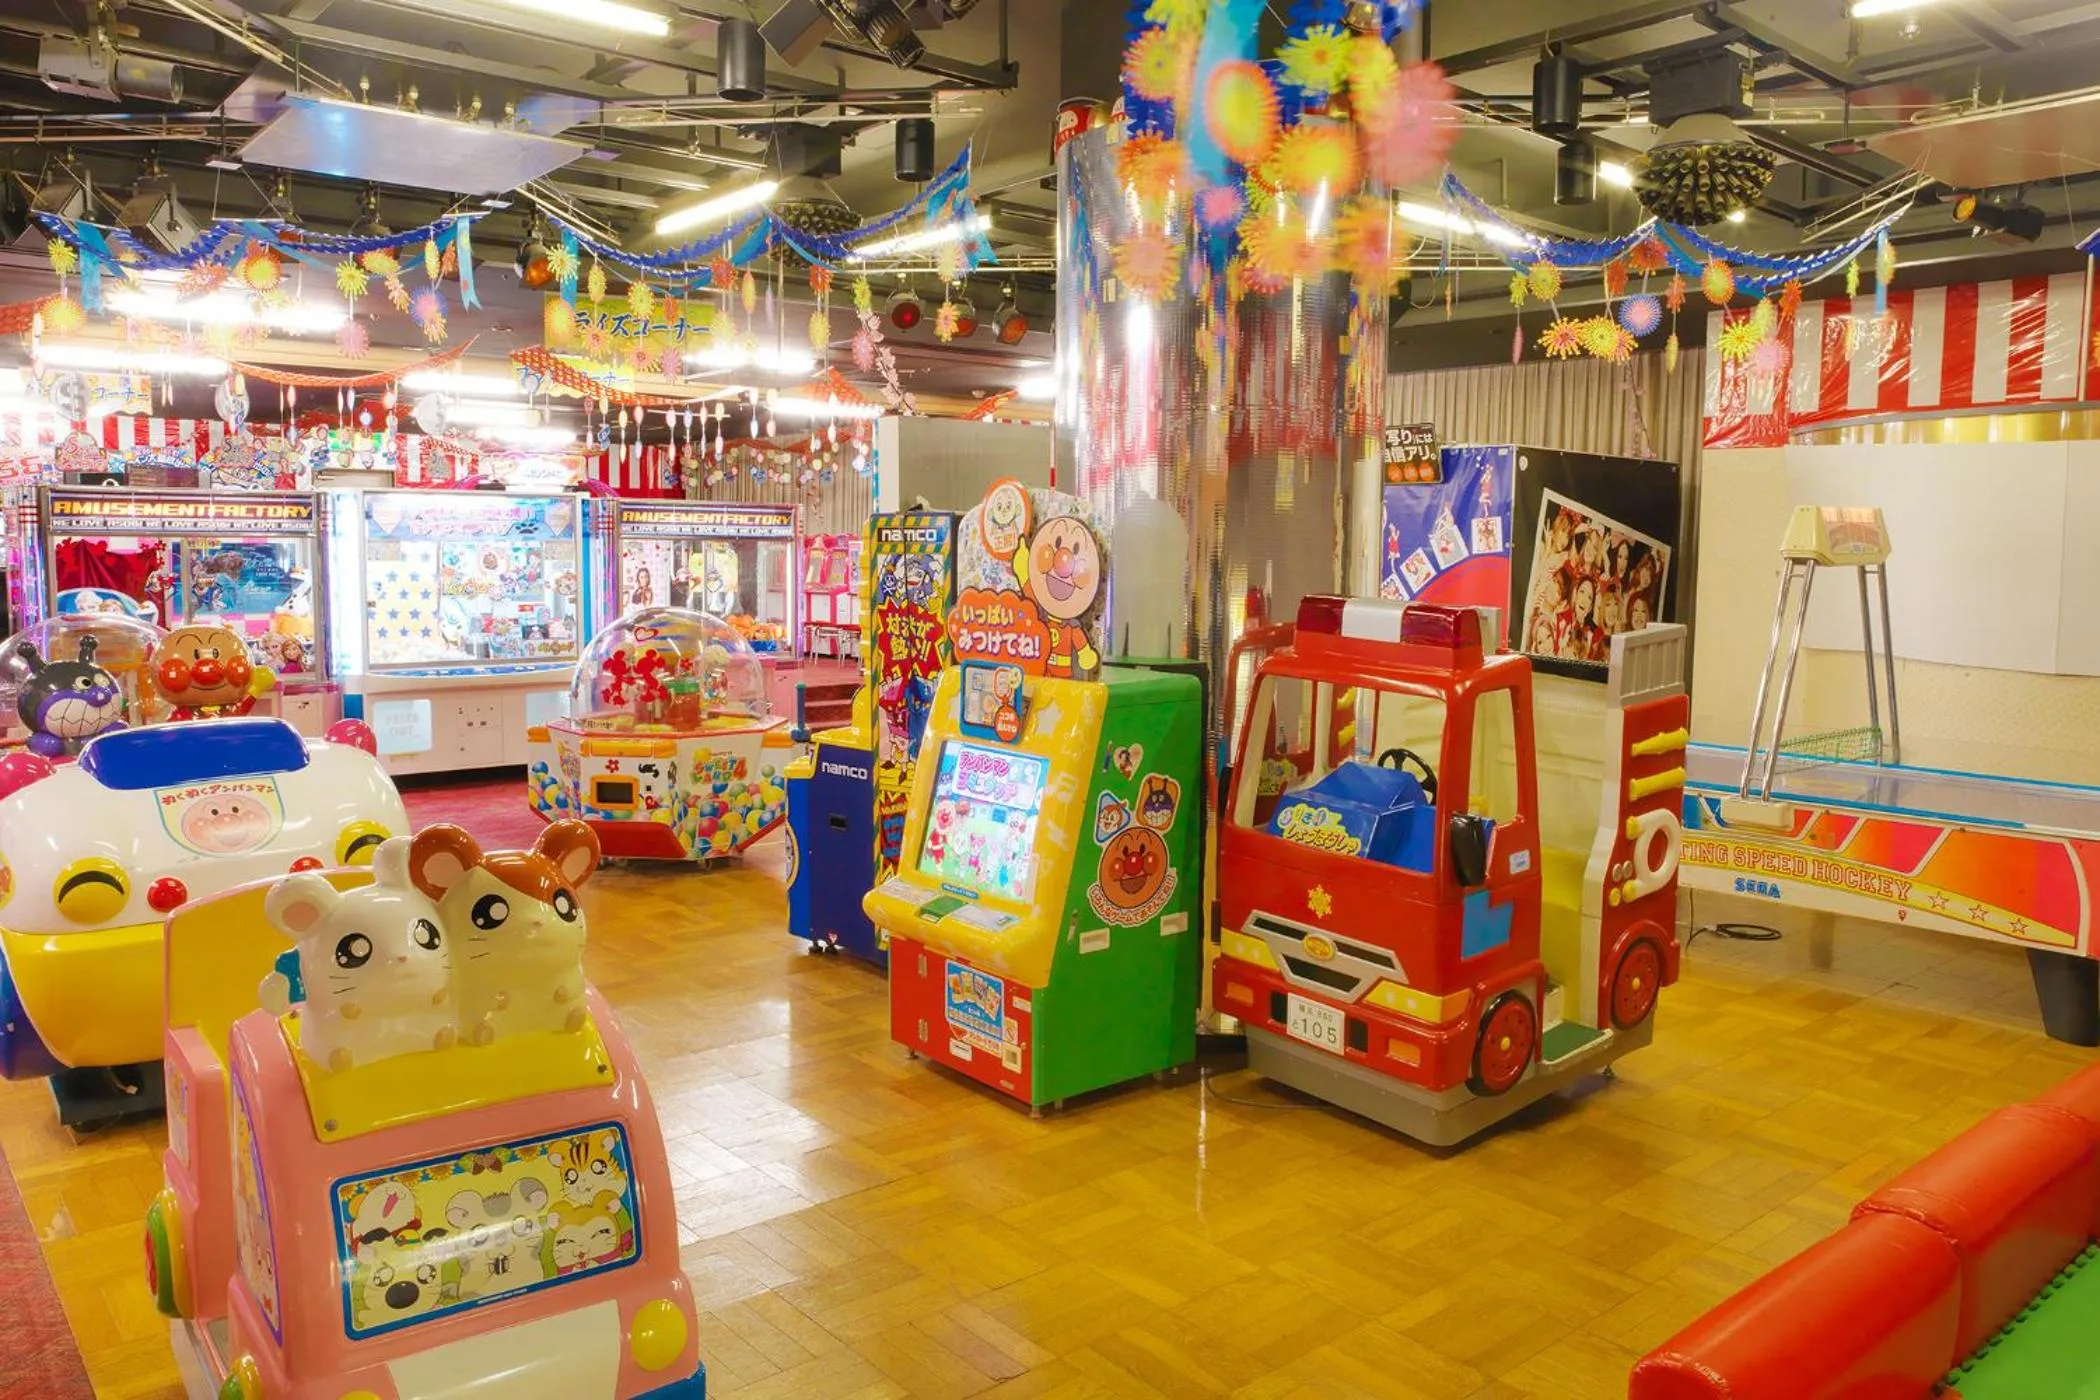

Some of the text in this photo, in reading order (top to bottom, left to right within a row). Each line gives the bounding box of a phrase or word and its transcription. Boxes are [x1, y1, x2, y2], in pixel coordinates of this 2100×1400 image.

[572, 311, 710, 342] ライズコーナー
[53, 501, 313, 518] AMUSEMENT FACTORY
[724, 513, 792, 526] FACTORY
[881, 528, 938, 542] namco
[962, 604, 1015, 627] いっぱい
[958, 627, 1041, 658] みつけてね!
[821, 762, 868, 780] namco
[1734, 846, 1808, 877] SPEED
[1811, 858, 1913, 901] HOCKEY
[1734, 877, 1782, 899] SEGA
[1302, 1018, 1337, 1044] 105
